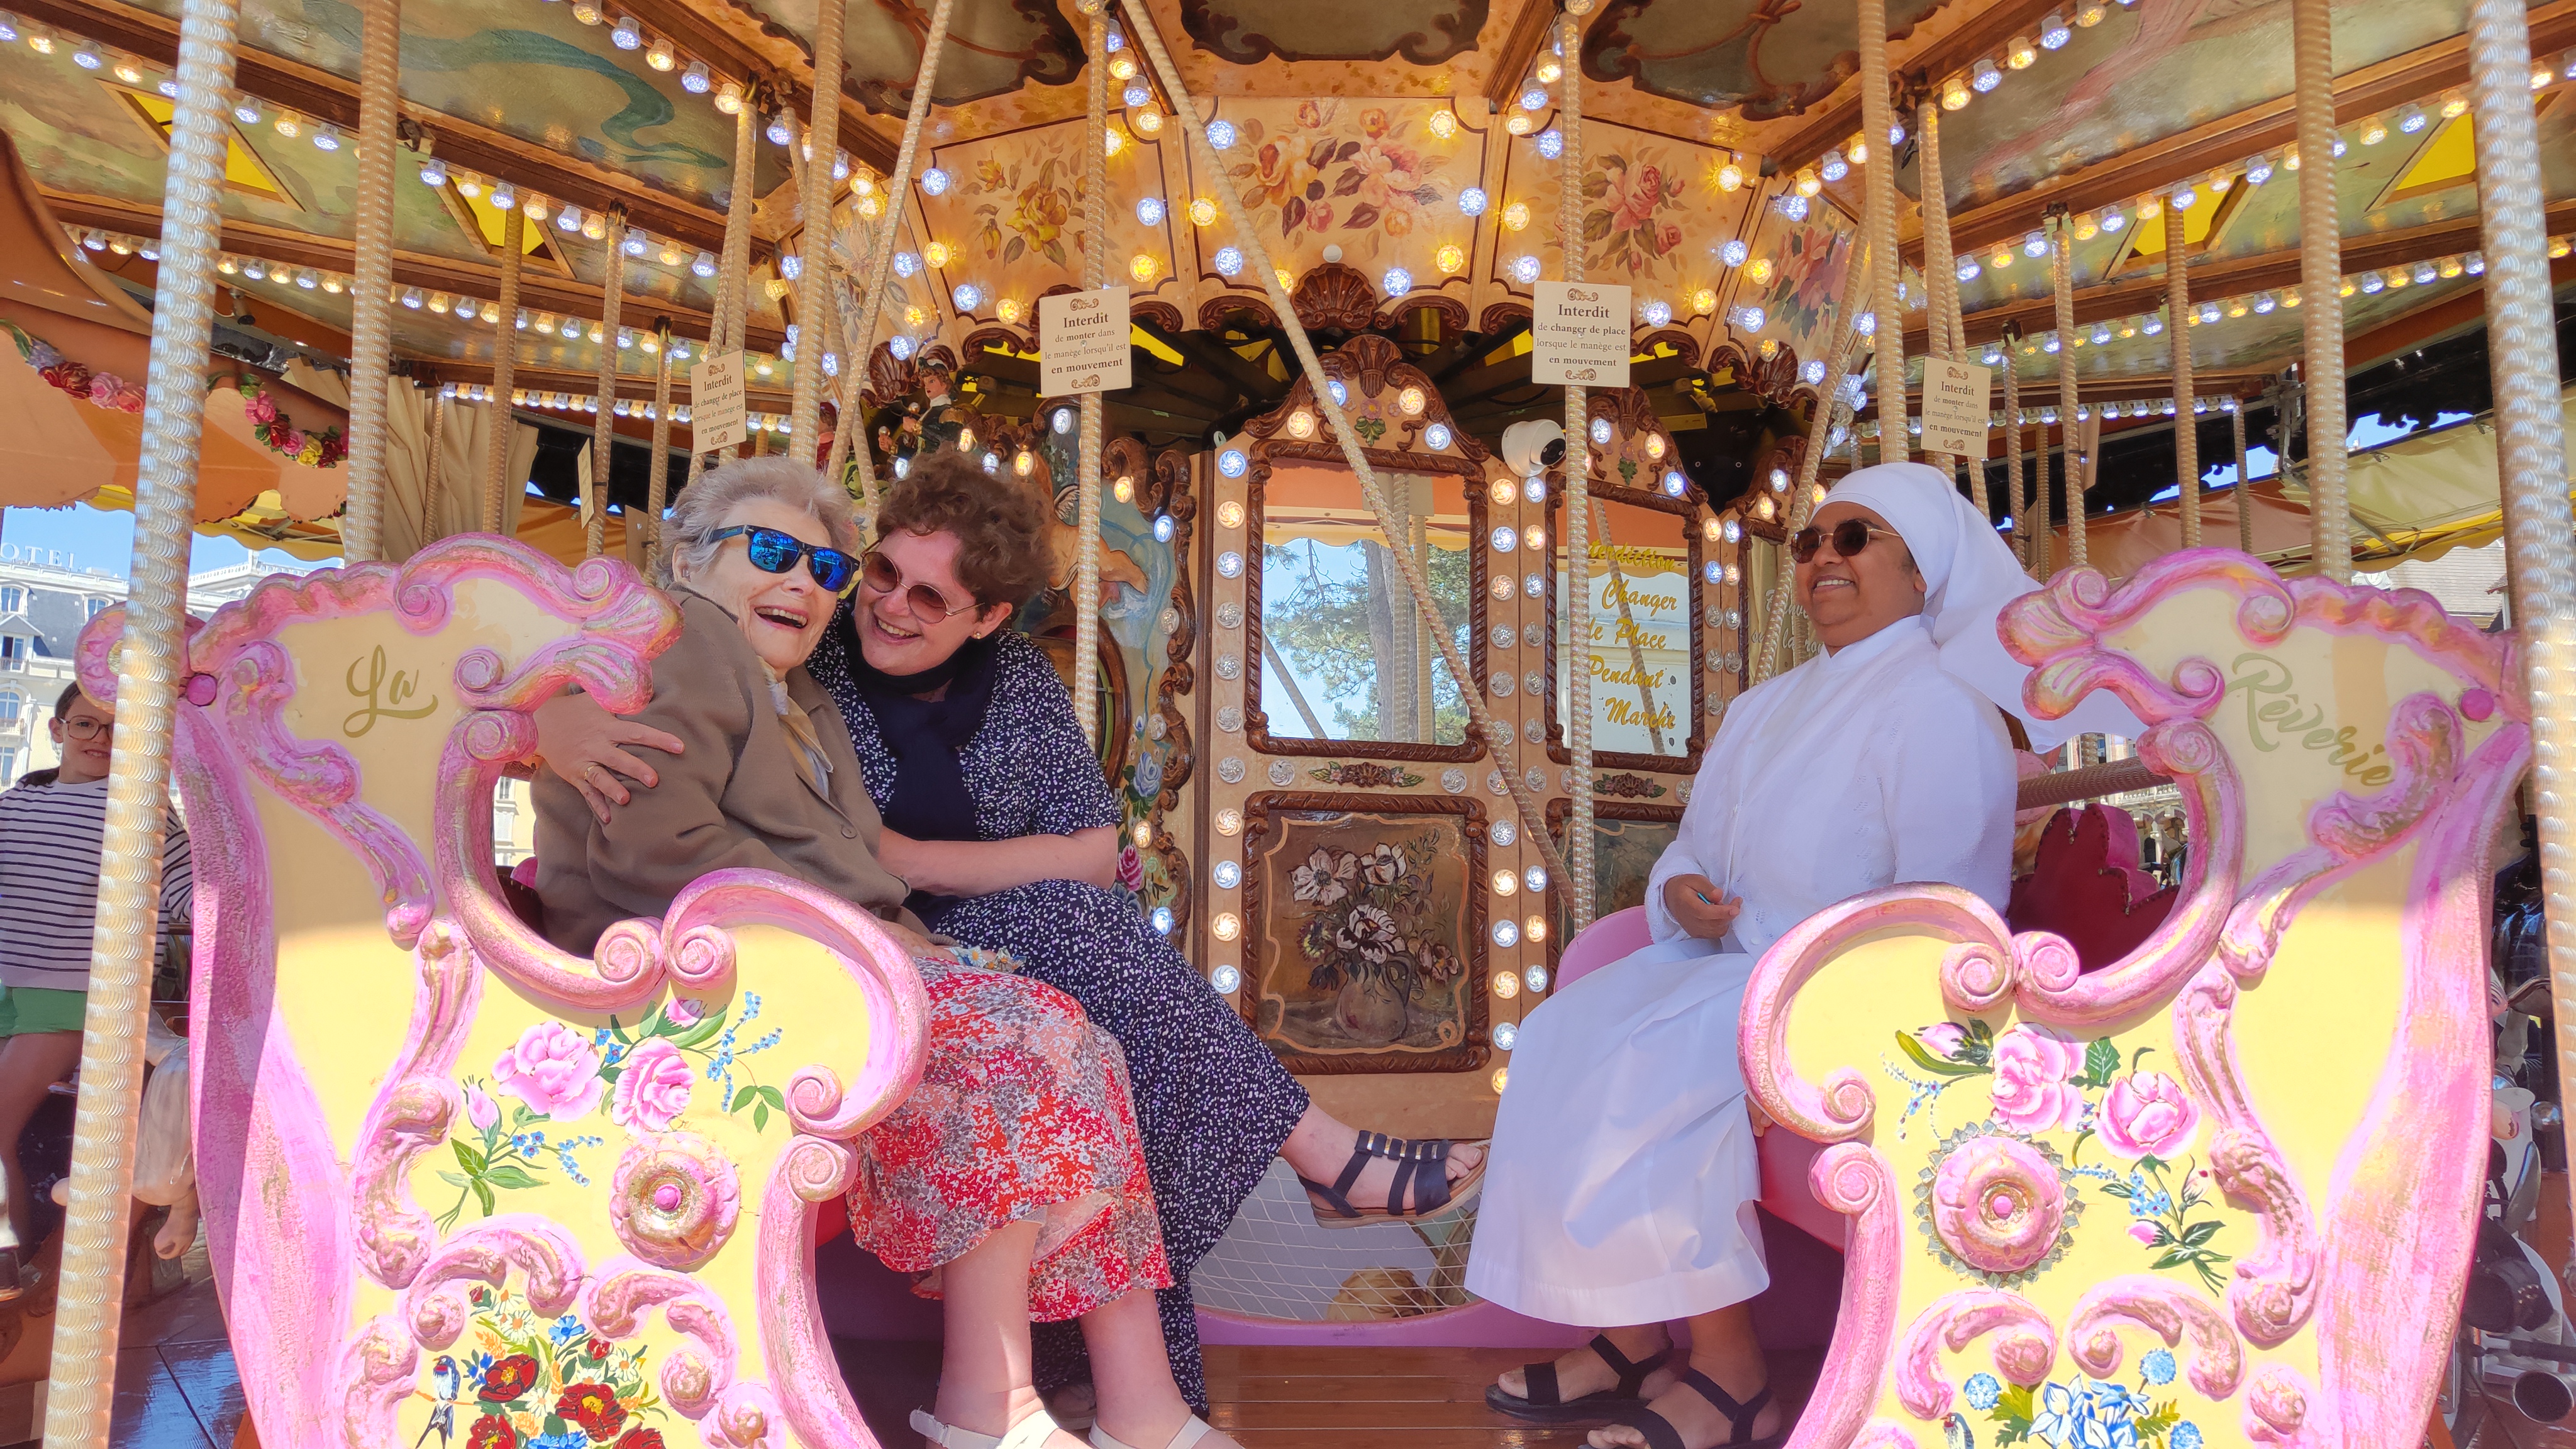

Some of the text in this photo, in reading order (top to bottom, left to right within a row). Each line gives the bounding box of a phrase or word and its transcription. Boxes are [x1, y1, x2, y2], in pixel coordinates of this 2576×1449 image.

[1558, 304, 1610, 318] Interdit
[1063, 313, 1108, 328] Interdit
[1067, 333, 1096, 341] monter
[1098, 329, 1115, 337] dans
[1538, 323, 1547, 331] de
[1551, 323, 1586, 334] changer
[1603, 326, 1626, 336] place
[1045, 352, 1051, 360] le
[1054, 349, 1081, 358] manège
[1084, 343, 1113, 355] lorsqu'il
[1536, 338, 1567, 350] lorsque
[1570, 340, 1577, 348] le
[1580, 342, 1612, 352] manège
[1067, 358, 1123, 372] mouvement
[1563, 358, 1617, 366] mouvement
[704, 375, 732, 391] Interdit
[1941, 381, 1975, 396] Interdit
[701, 396, 720, 406] changer
[729, 389, 742, 400] place
[694, 413, 711, 423] lorsque
[718, 405, 735, 416] manège
[1932, 411, 1953, 420] manège
[1955, 412, 1975, 423] lorsqu'il
[709, 419, 738, 432] mouvement
[1940, 426, 1982, 437] mouvement
[1589, 538, 1675, 571] terdiction
[1602, 579, 1677, 616] Changer
[1615, 618, 1666, 649] Place
[343, 645, 438, 738] La
[1606, 697, 1676, 730] Marche
[2223, 653, 2395, 786] Rêverie
